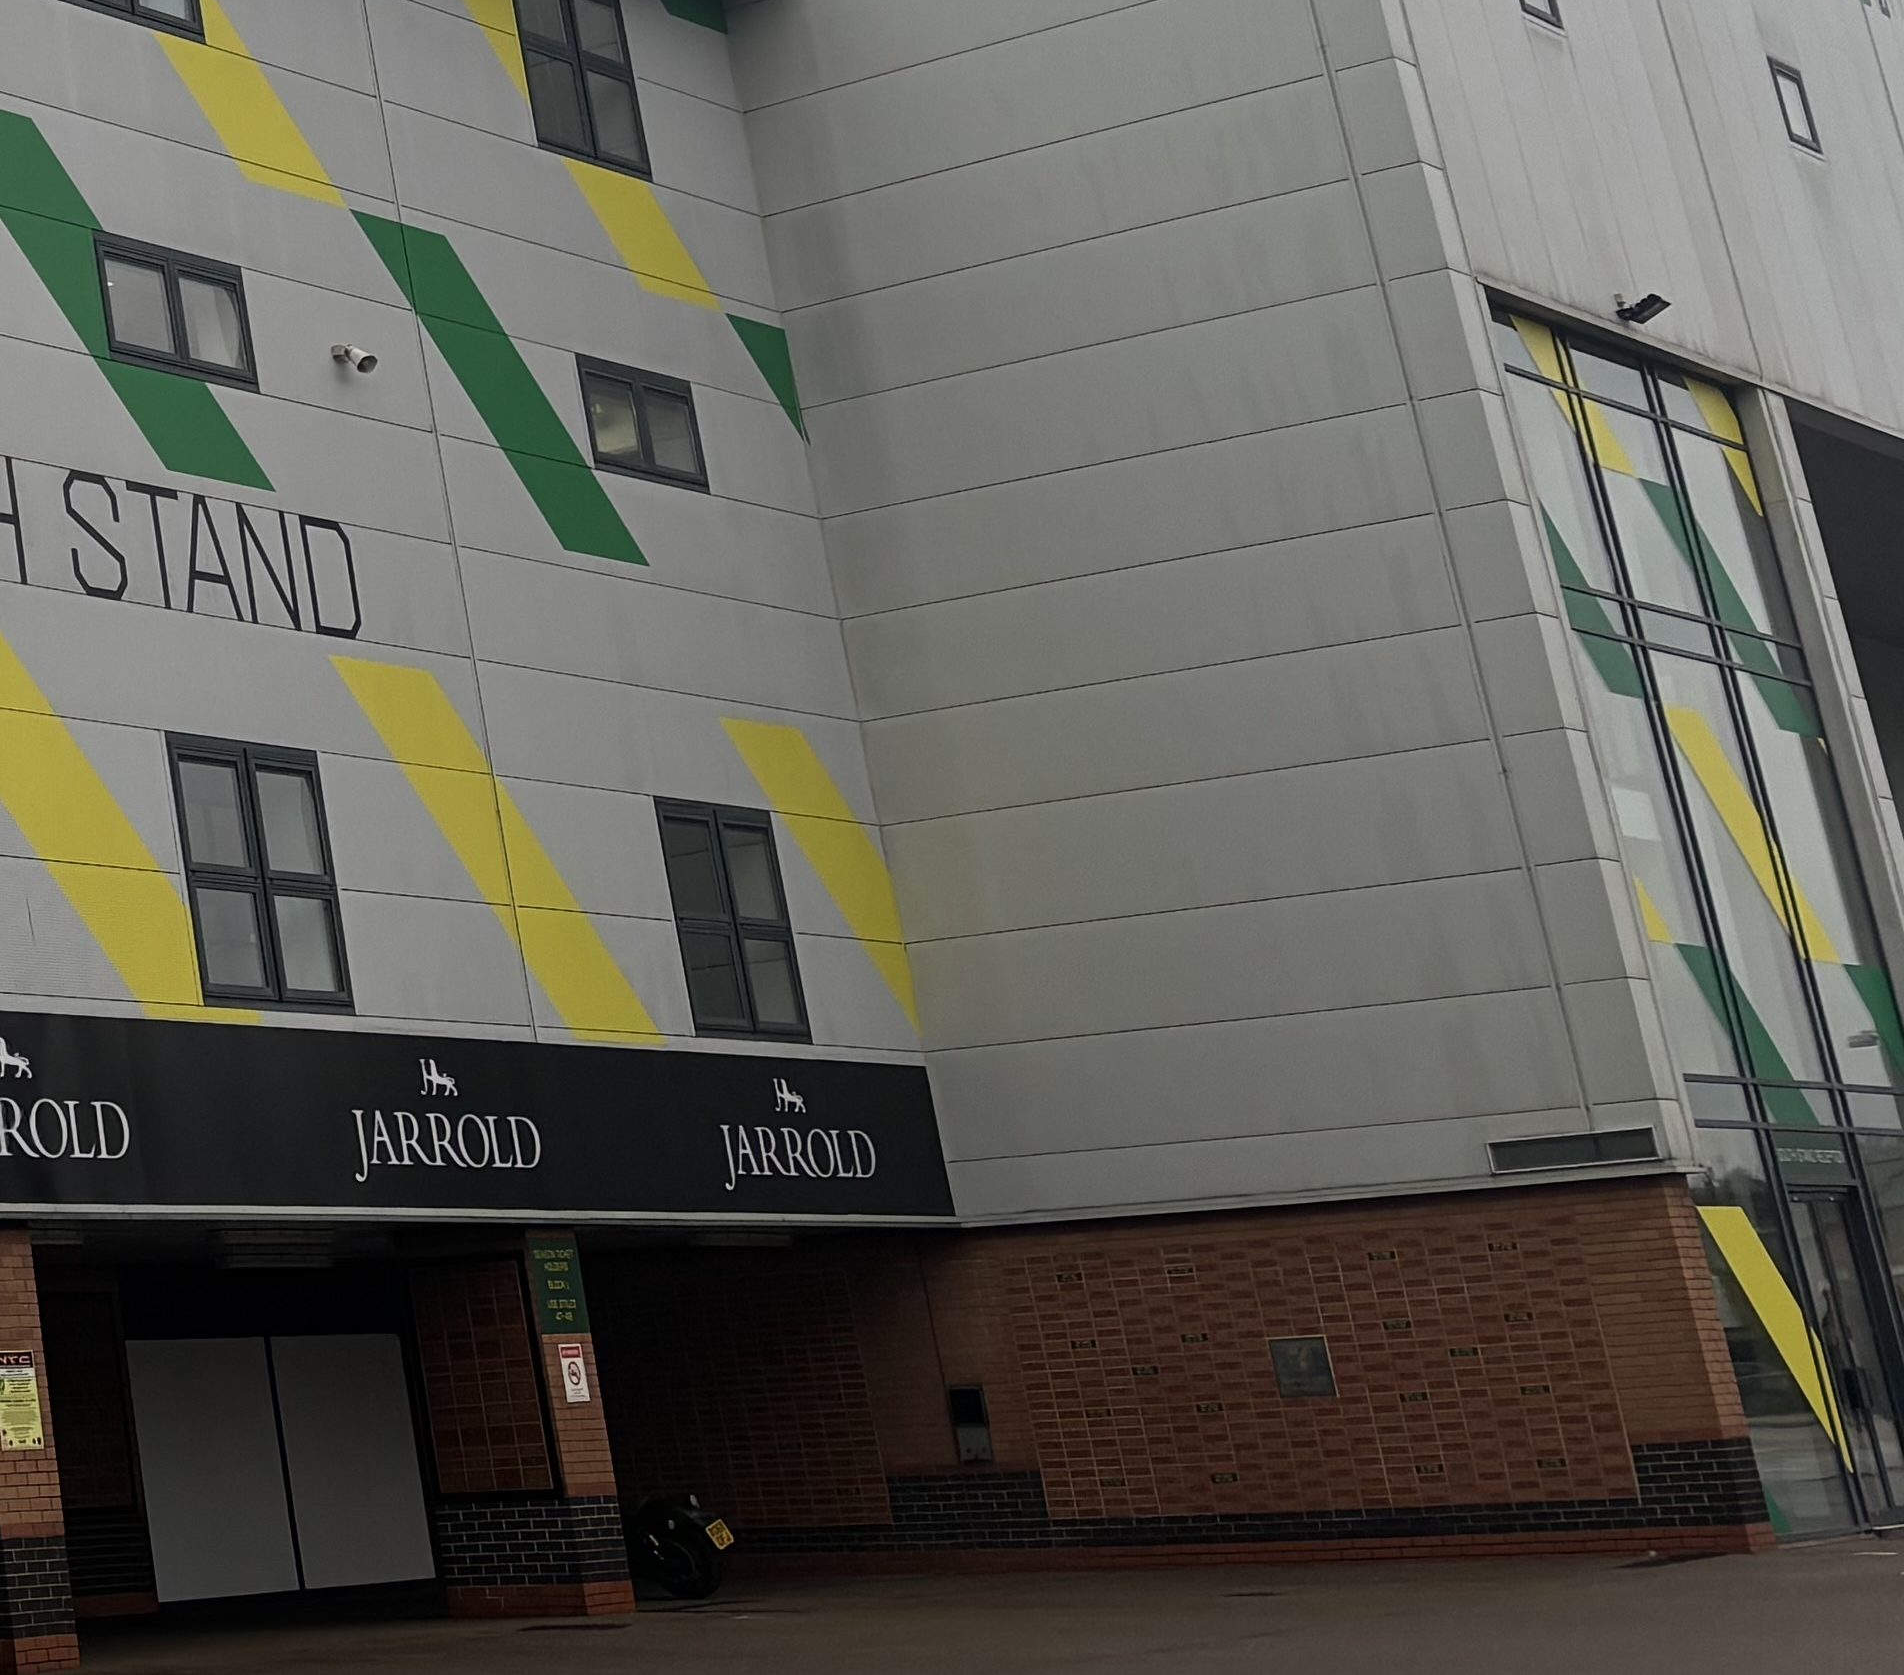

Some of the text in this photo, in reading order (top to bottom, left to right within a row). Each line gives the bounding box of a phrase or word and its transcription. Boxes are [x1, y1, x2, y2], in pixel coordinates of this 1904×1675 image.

[62, 470, 362, 639] STAND
[351, 1108, 542, 1183] JARROLD
[720, 1123, 877, 1192] JARROLD
